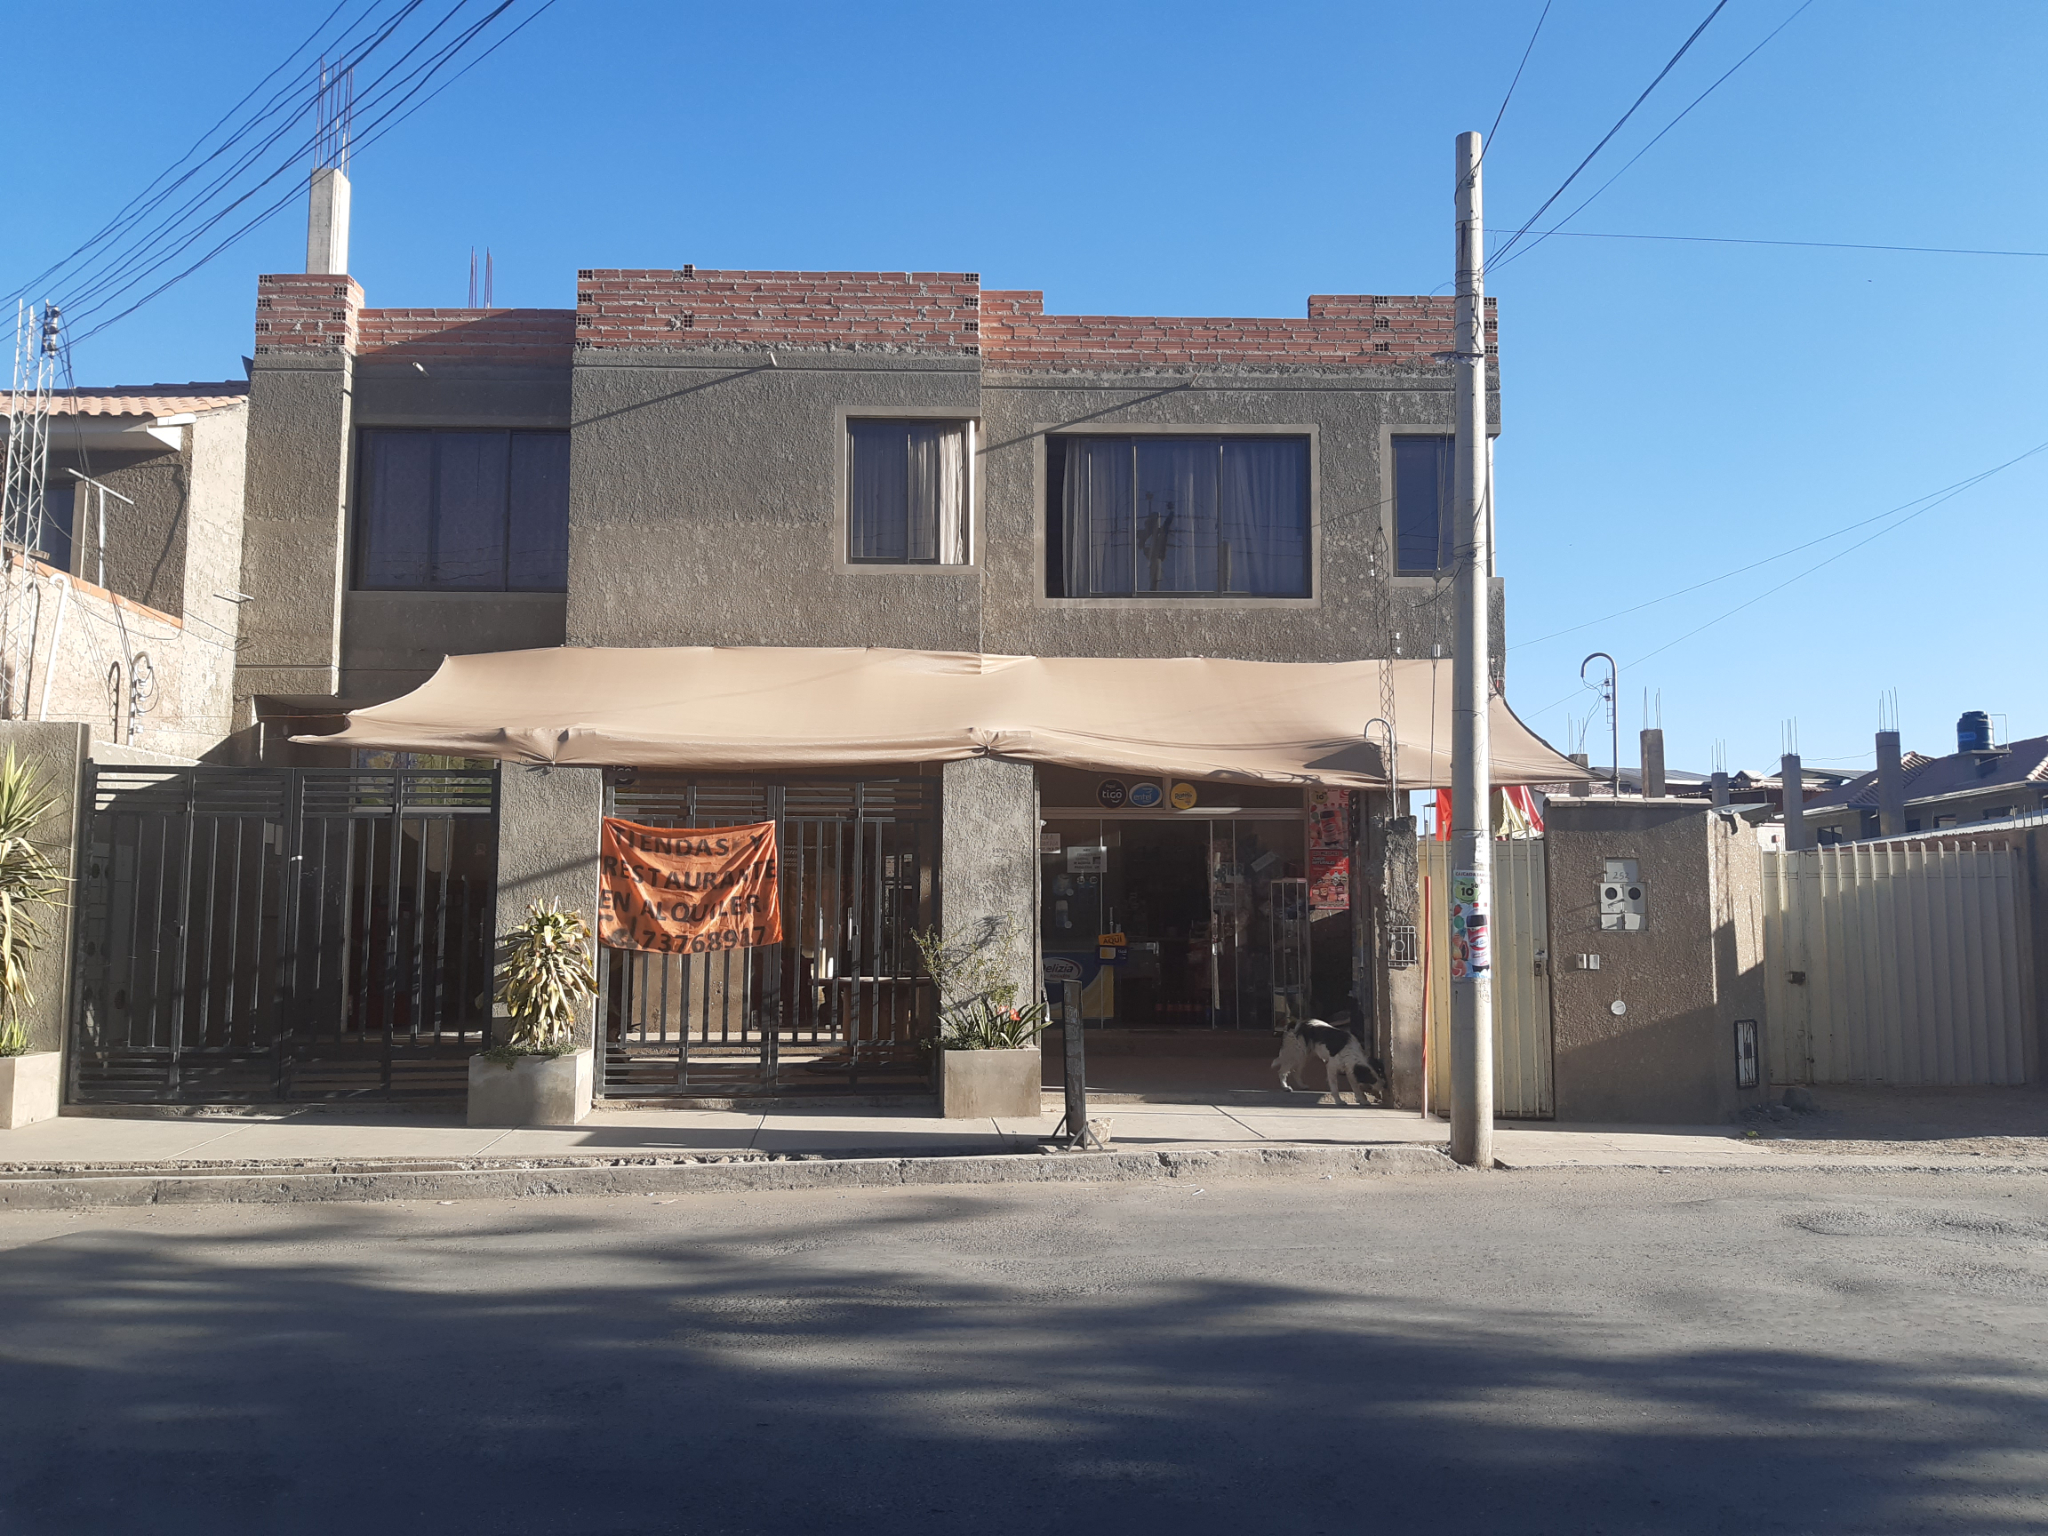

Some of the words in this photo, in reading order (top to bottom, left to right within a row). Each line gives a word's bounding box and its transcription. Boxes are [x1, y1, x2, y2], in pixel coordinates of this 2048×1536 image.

[616, 827, 729, 857] TIENDAS
[602, 855, 776, 890] RESTAURANTE
[1613, 871, 1630, 881] 252
[1461, 887, 1475, 897] 10
[600, 890, 630, 912] EN
[640, 894, 761, 923] ALQUILER
[641, 926, 767, 953] 73768917
